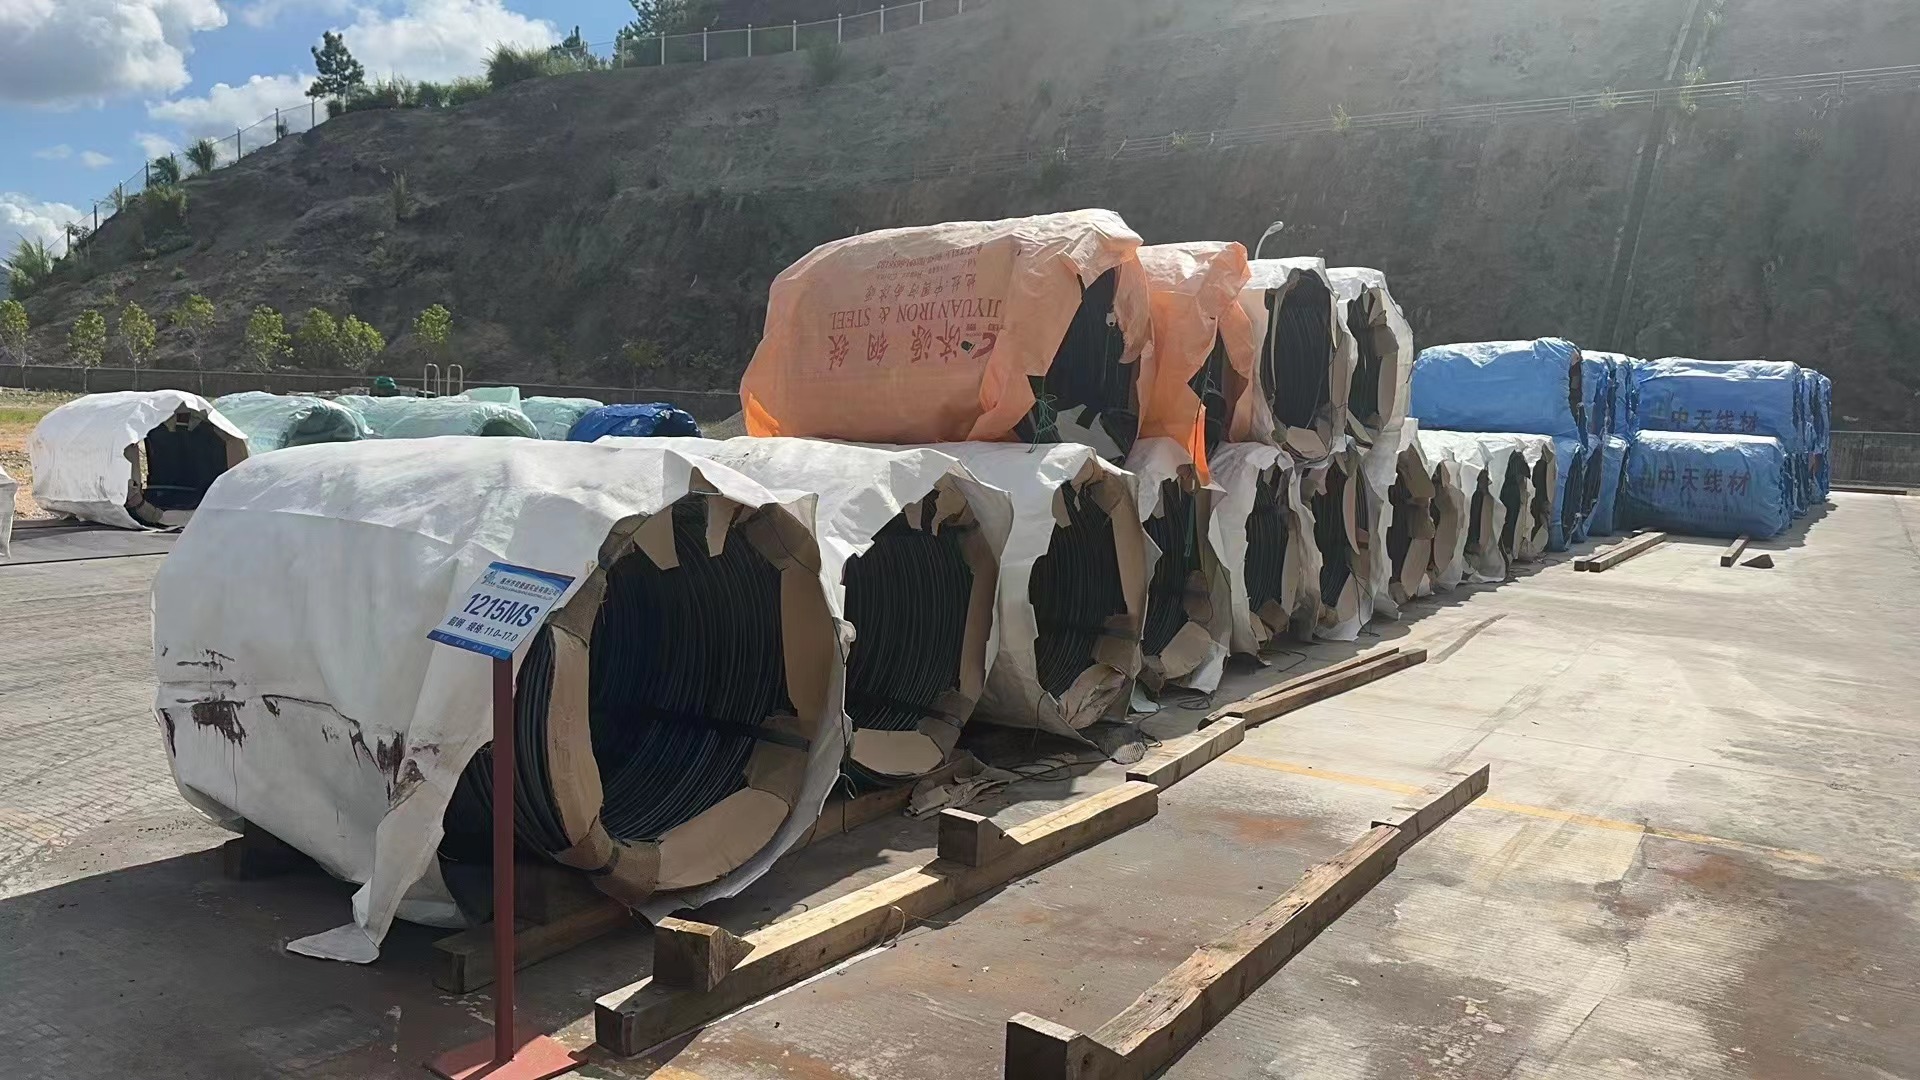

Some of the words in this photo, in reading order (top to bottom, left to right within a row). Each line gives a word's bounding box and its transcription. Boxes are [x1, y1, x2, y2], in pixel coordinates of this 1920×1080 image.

[831, 307, 871, 330] STEEL
[880, 306, 891, 324] &
[1671, 408, 1759, 433] 中天线材
[1658, 465, 1751, 497] 中天线材
[463, 593, 540, 627] 1215MS
